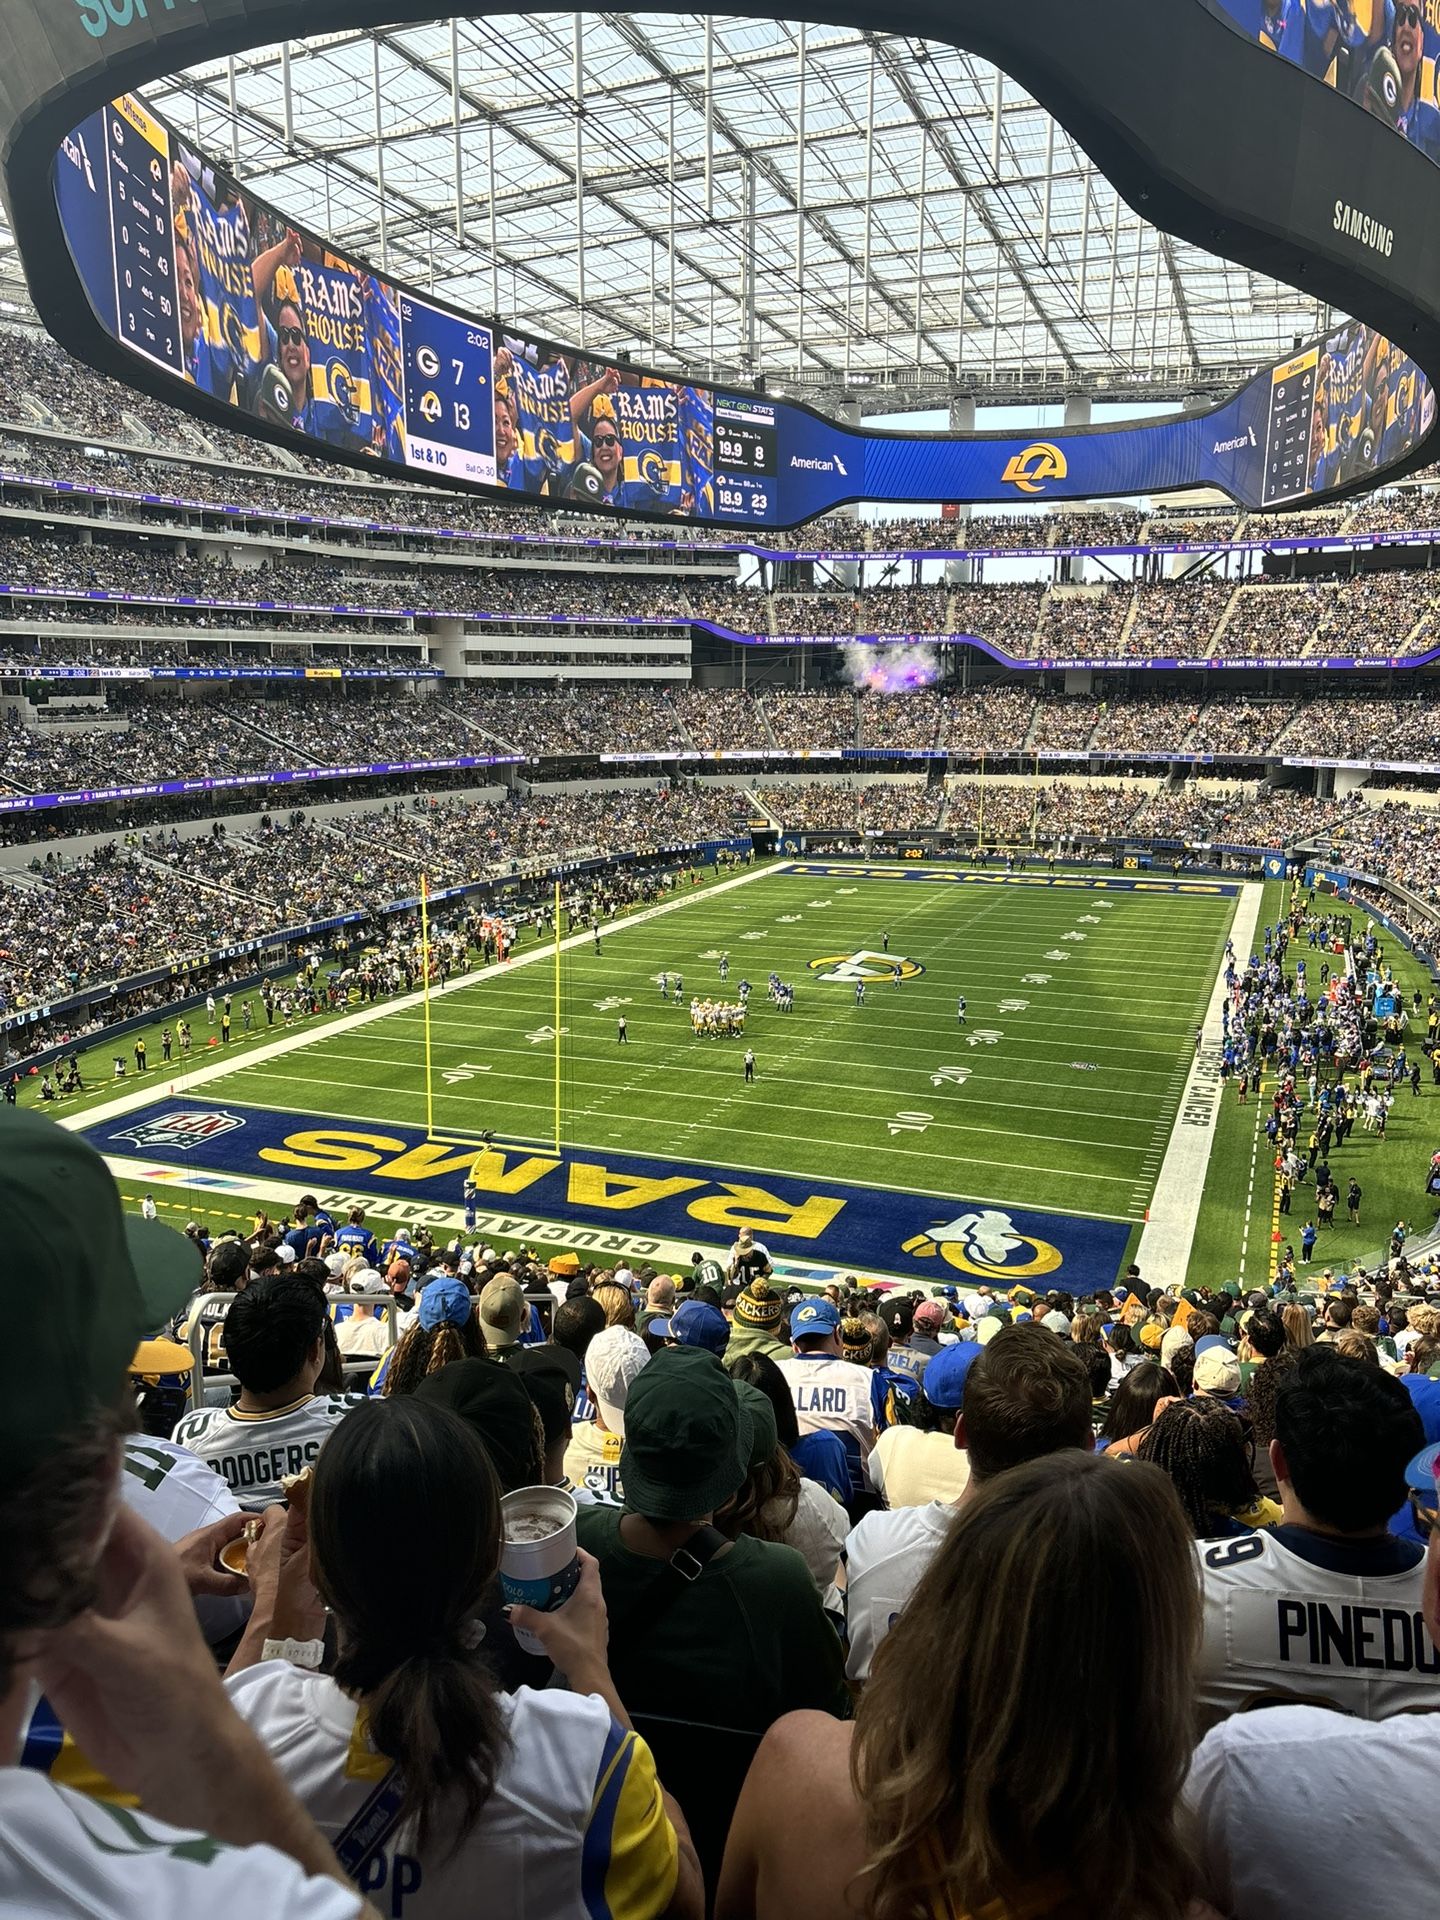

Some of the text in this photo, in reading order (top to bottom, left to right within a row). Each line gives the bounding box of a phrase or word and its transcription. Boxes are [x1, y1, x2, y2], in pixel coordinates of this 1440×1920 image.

[122, 96, 148, 133] Offense
[118, 180, 126, 201] 5
[122, 225, 129, 245] 0
[155, 214, 165, 236] 10
[1333, 200, 1394, 257] SAMSUNG
[157, 255, 169, 277] 43
[125, 269, 132, 289] 0
[299, 265, 364, 319] RAMS
[160, 295, 172, 318] 50
[128, 312, 136, 332] 3
[305, 308, 366, 354] HOUSE
[165, 337, 173, 355] 2
[467, 331, 489, 350] 2:02
[451, 358, 464, 386] 7
[512, 361, 568, 401] RAMS
[453, 402, 470, 431] 13
[617, 391, 678, 421] RAMS
[716, 399, 775, 416] NEXT GEN STATS
[1276, 407, 1307, 428] 5 10
[620, 419, 679, 443] HOUSE
[1275, 430, 1306, 451] 0 43
[410, 443, 447, 467] 1st & 10
[719, 440, 764, 460] 19.9 8
[1213, 434, 1249, 455] American
[485, 465, 495, 477] 30
[790, 455, 833, 471] American
[1273, 453, 1304, 474] 0 50
[1270, 477, 1301, 496] 3 2
[719, 490, 768, 509] 18.9 23
[664, 843, 697, 853] HOUSE
[904, 849, 922, 859] 2:02
[551, 863, 581, 874] HOUSE
[1125, 857, 1137, 868] 22
[792, 867, 1222, 893] LOS ANGELES
[171, 939, 264, 975] RAMS HOUSE
[966, 1029, 1004, 1044] 30
[442, 1062, 493, 1080] 10
[930, 1066, 973, 1085] 20
[1181, 1085, 1217, 1127] CANCER
[159, 1113, 234, 1136] NFL
[888, 1111, 934, 1132] 10
[258, 1130, 848, 1238] RAMS
[319, 1195, 661, 1255] CRUCIAL CATCH
[701, 1265, 718, 1284] 10
[796, 1387, 846, 1412] LARD
